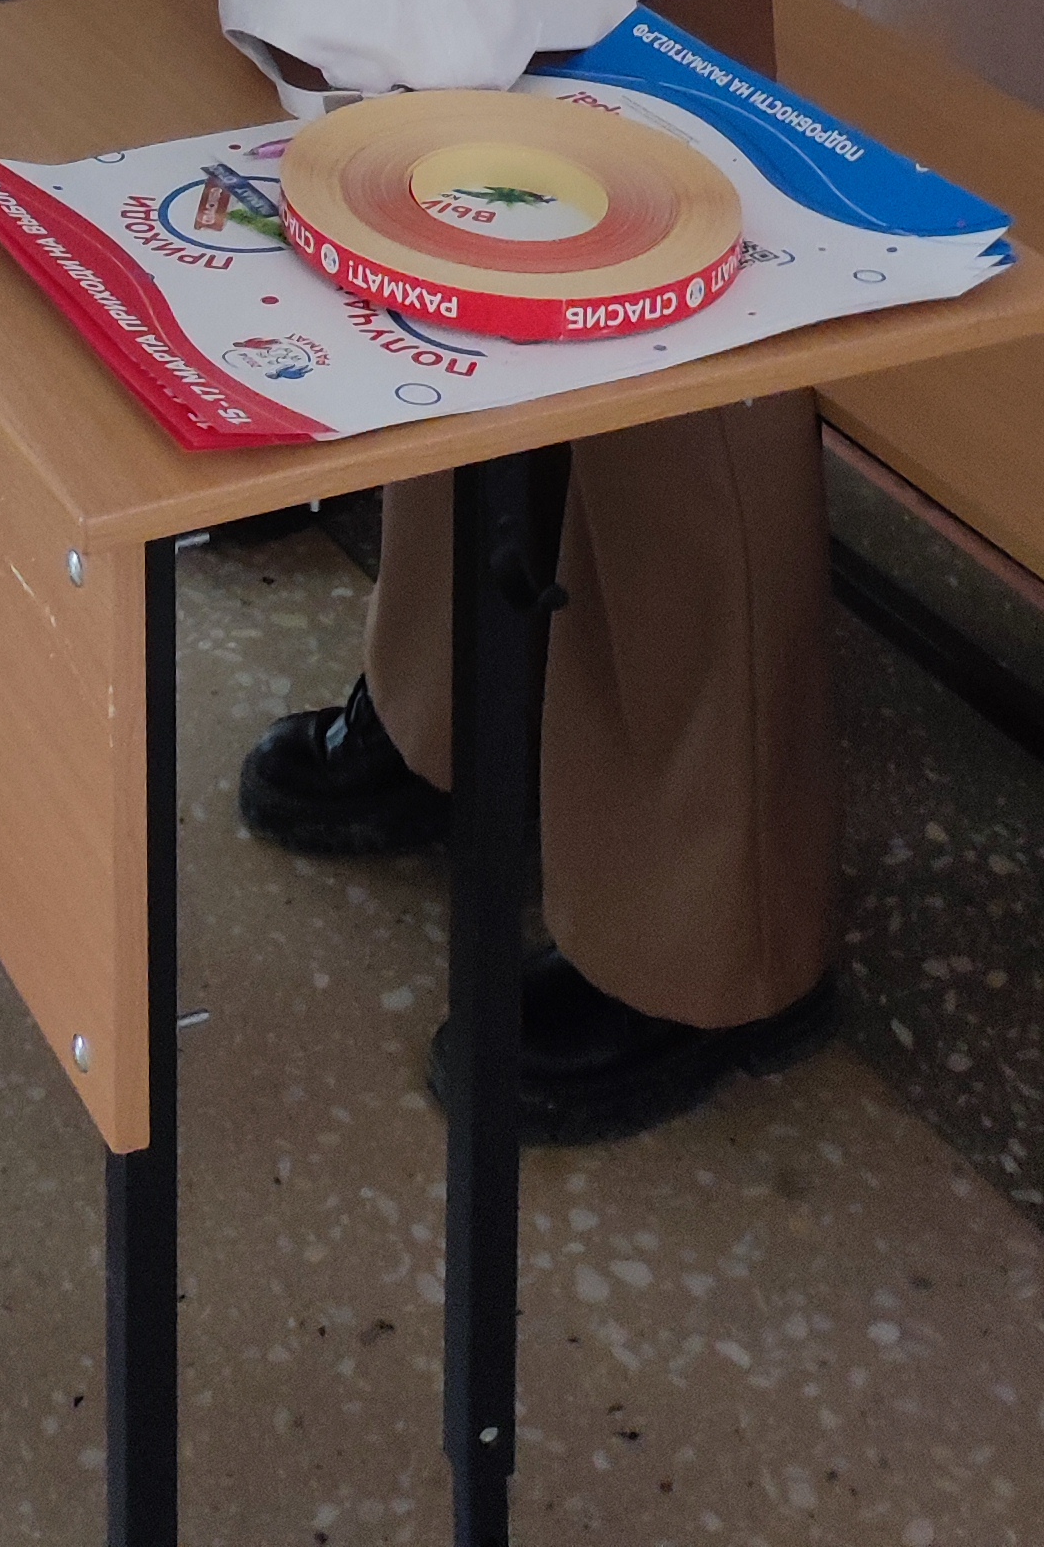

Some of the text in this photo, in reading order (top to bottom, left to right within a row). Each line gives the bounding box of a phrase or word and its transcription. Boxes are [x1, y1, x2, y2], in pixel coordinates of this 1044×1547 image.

[729, 80, 755, 99] НА
[749, 92, 864, 162] ПОДРОБНОСТИ
[35, 237, 72, 258] НА
[120, 195, 234, 270] ПРИХОДИ
[57, 259, 149, 332] ПРИХОДИ
[348, 260, 458, 318] РАХМАТ!
[566, 291, 677, 330] СПАСИБ
[339, 286, 478, 377] ПОЛУЧА
[135, 334, 206, 384] МАРТА
[189, 385, 252, 425] 15-17
